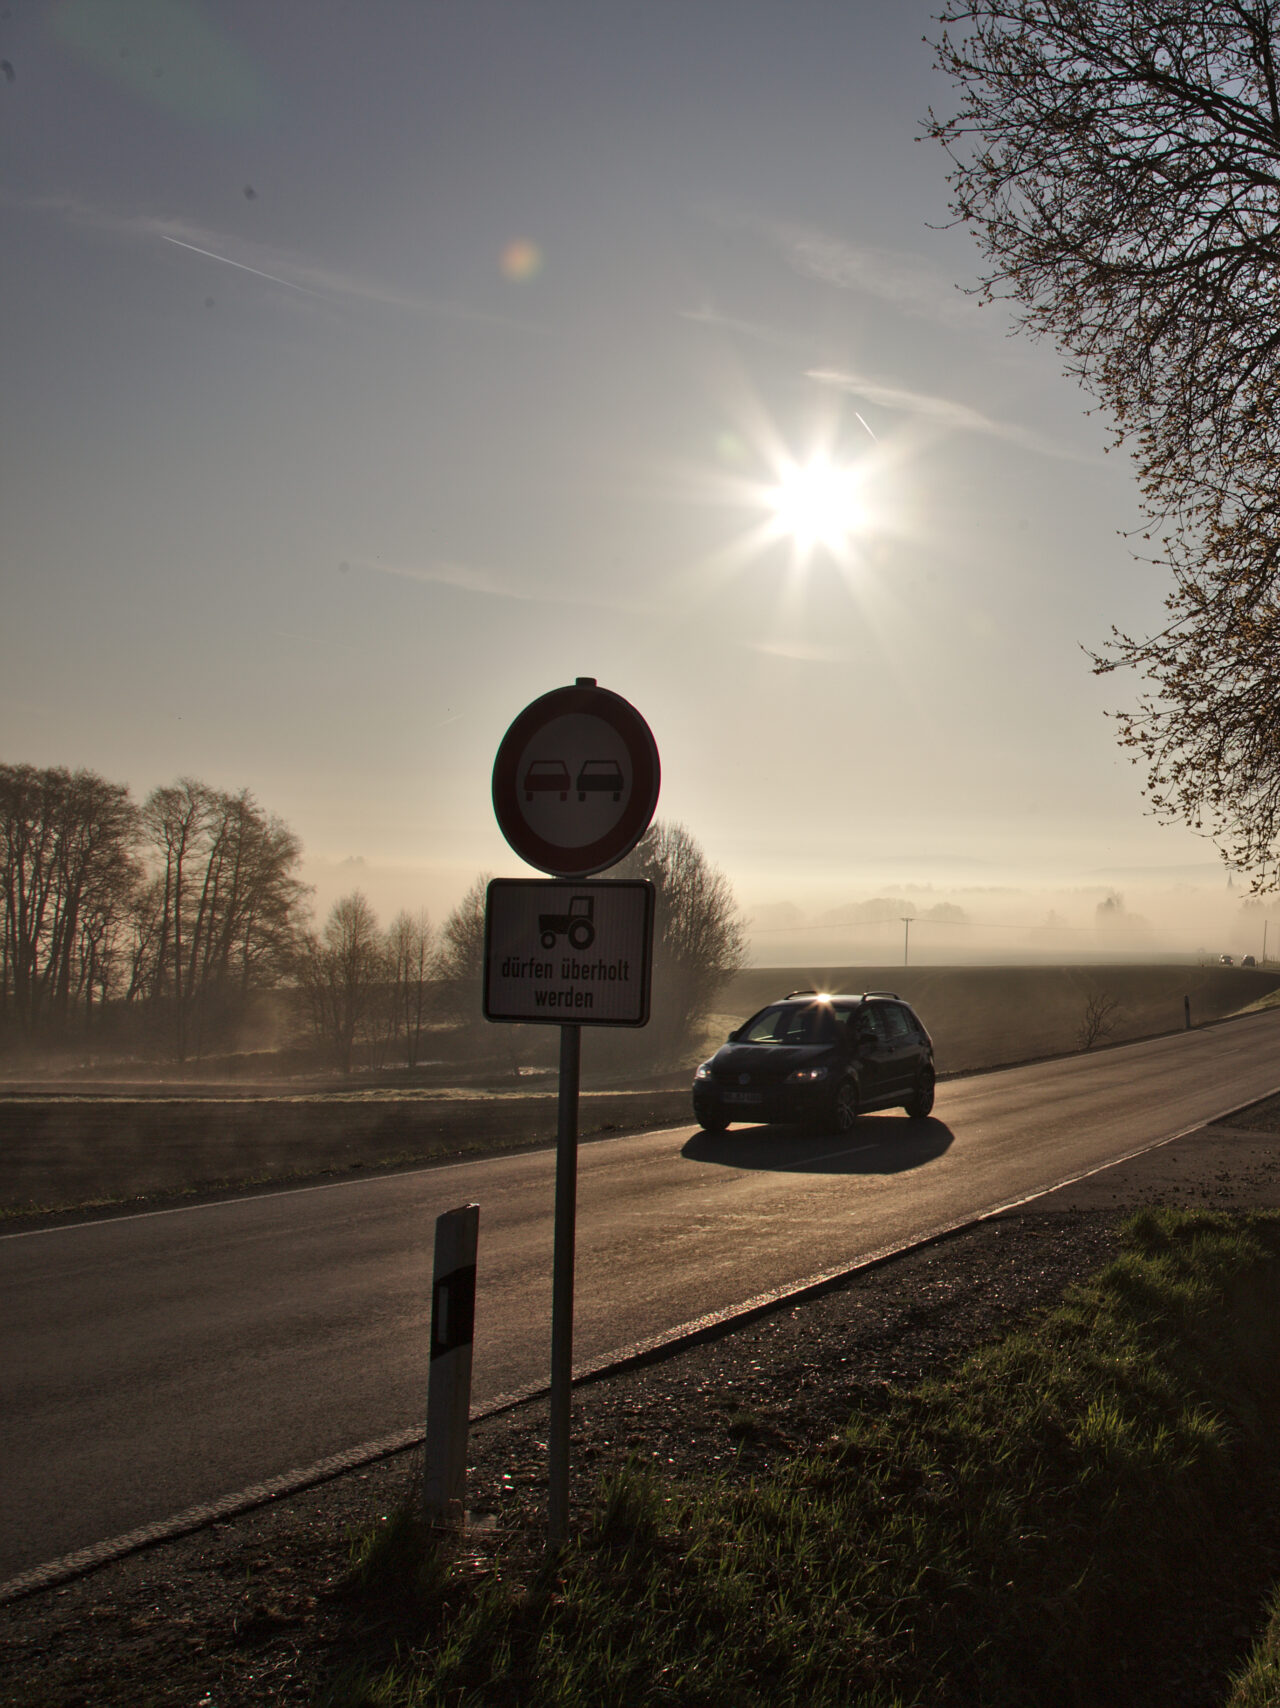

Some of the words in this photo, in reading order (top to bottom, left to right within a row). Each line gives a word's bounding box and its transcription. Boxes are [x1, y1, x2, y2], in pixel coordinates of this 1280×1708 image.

[502, 957, 553, 978] dürfen
[561, 958, 629, 981] überholt
[535, 986, 593, 1008] werden
